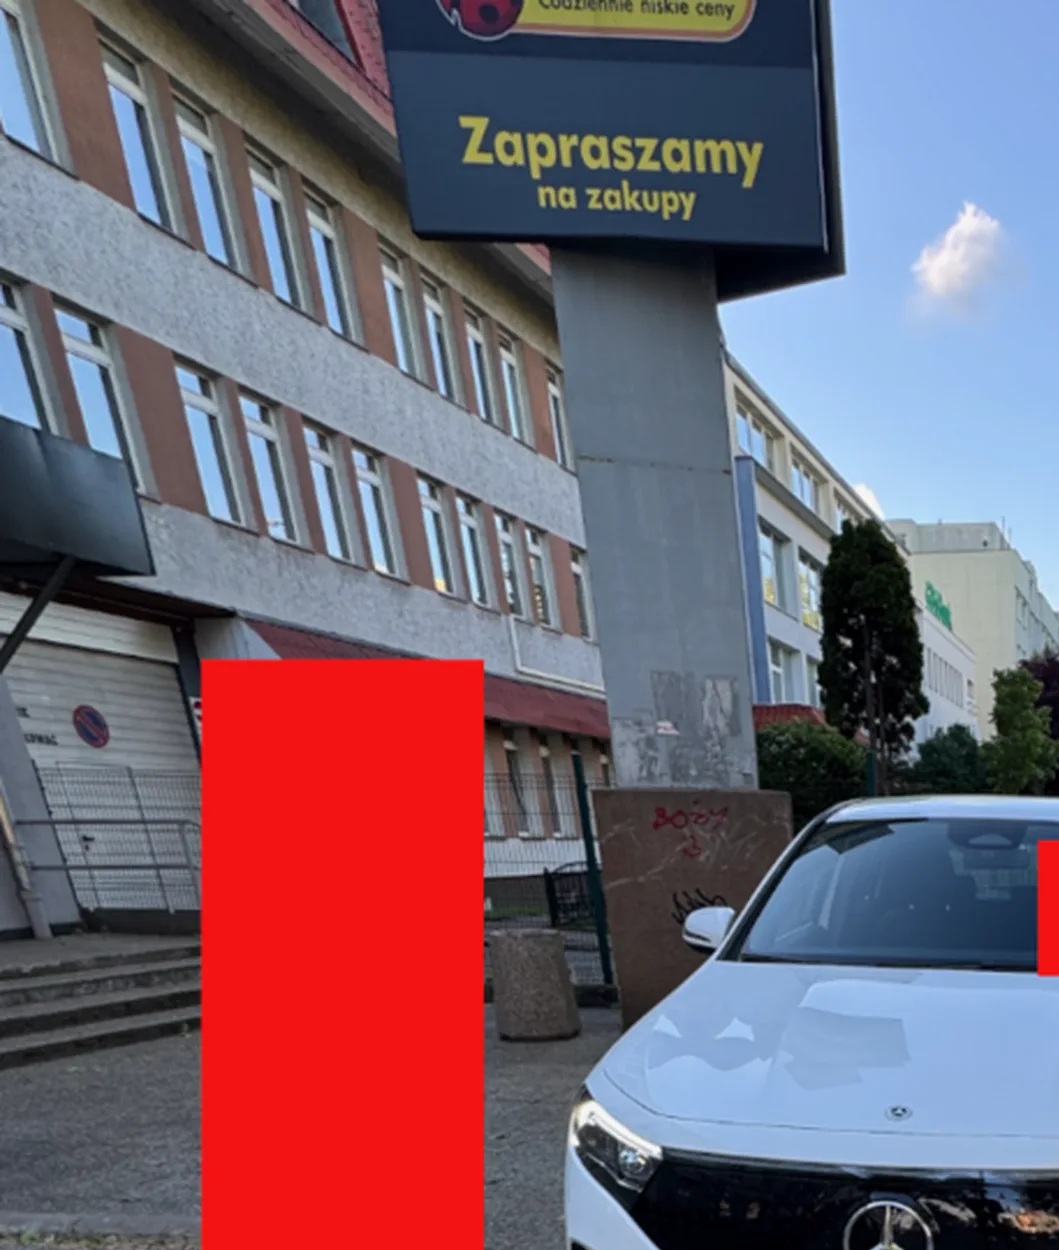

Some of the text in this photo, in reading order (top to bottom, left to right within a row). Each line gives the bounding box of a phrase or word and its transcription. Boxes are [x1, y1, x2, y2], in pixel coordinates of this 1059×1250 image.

[695, 1, 735, 20] ceny
[458, 115, 764, 189] Zapraszamy
[537, 180, 696, 221] na zakupy
